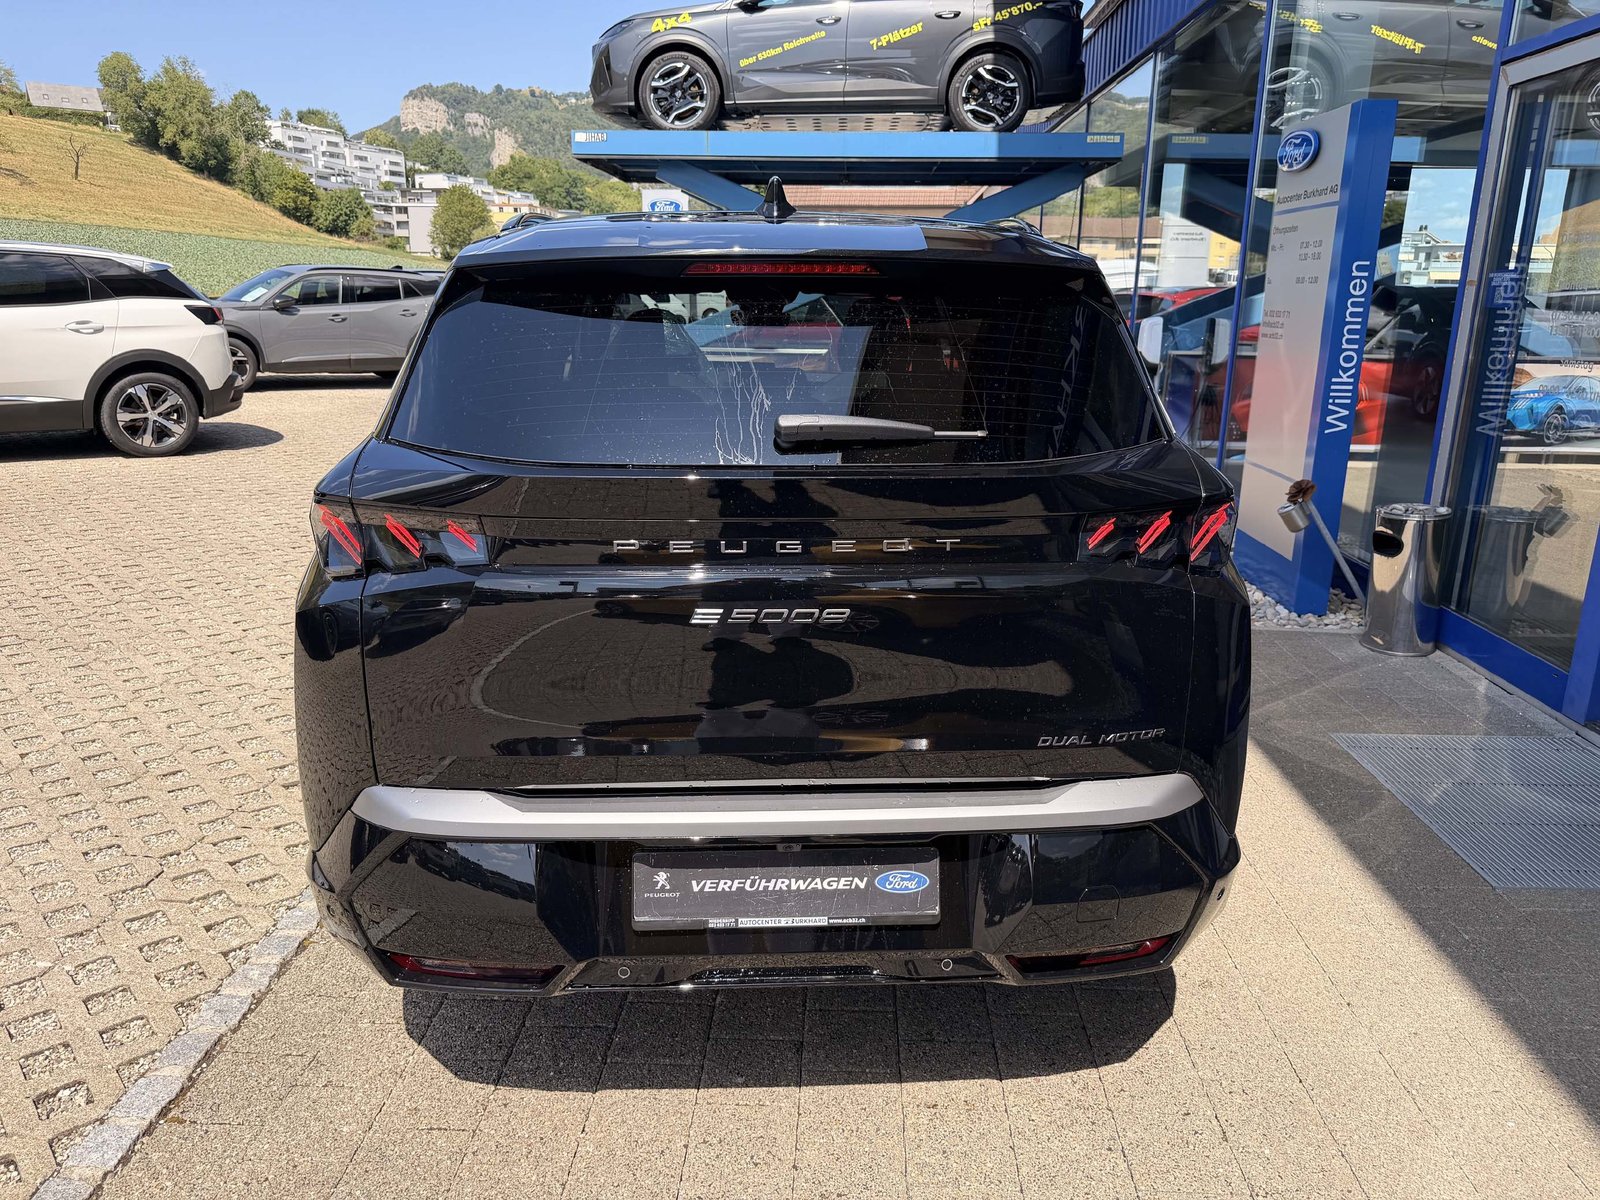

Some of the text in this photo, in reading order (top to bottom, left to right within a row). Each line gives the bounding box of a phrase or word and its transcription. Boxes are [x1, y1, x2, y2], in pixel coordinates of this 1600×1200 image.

[651, 11, 692, 33] 4x4
[972, 17, 992, 32] sFr
[869, 21, 924, 50] 7-Plätzer
[758, 46, 783, 63] 530km
[783, 30, 826, 52] Reichweite
[1277, 183, 1339, 205] Autocenter Burkhard AG
[1324, 260, 1371, 434] Willkommen
[613, 538, 961, 553] PEUGEOT
[1037, 728, 1166, 747] DUAL MOTOR
[691, 876, 868, 892] VERFÜHRWAGEN
[739, 918, 782, 926] AUTOCENTER
